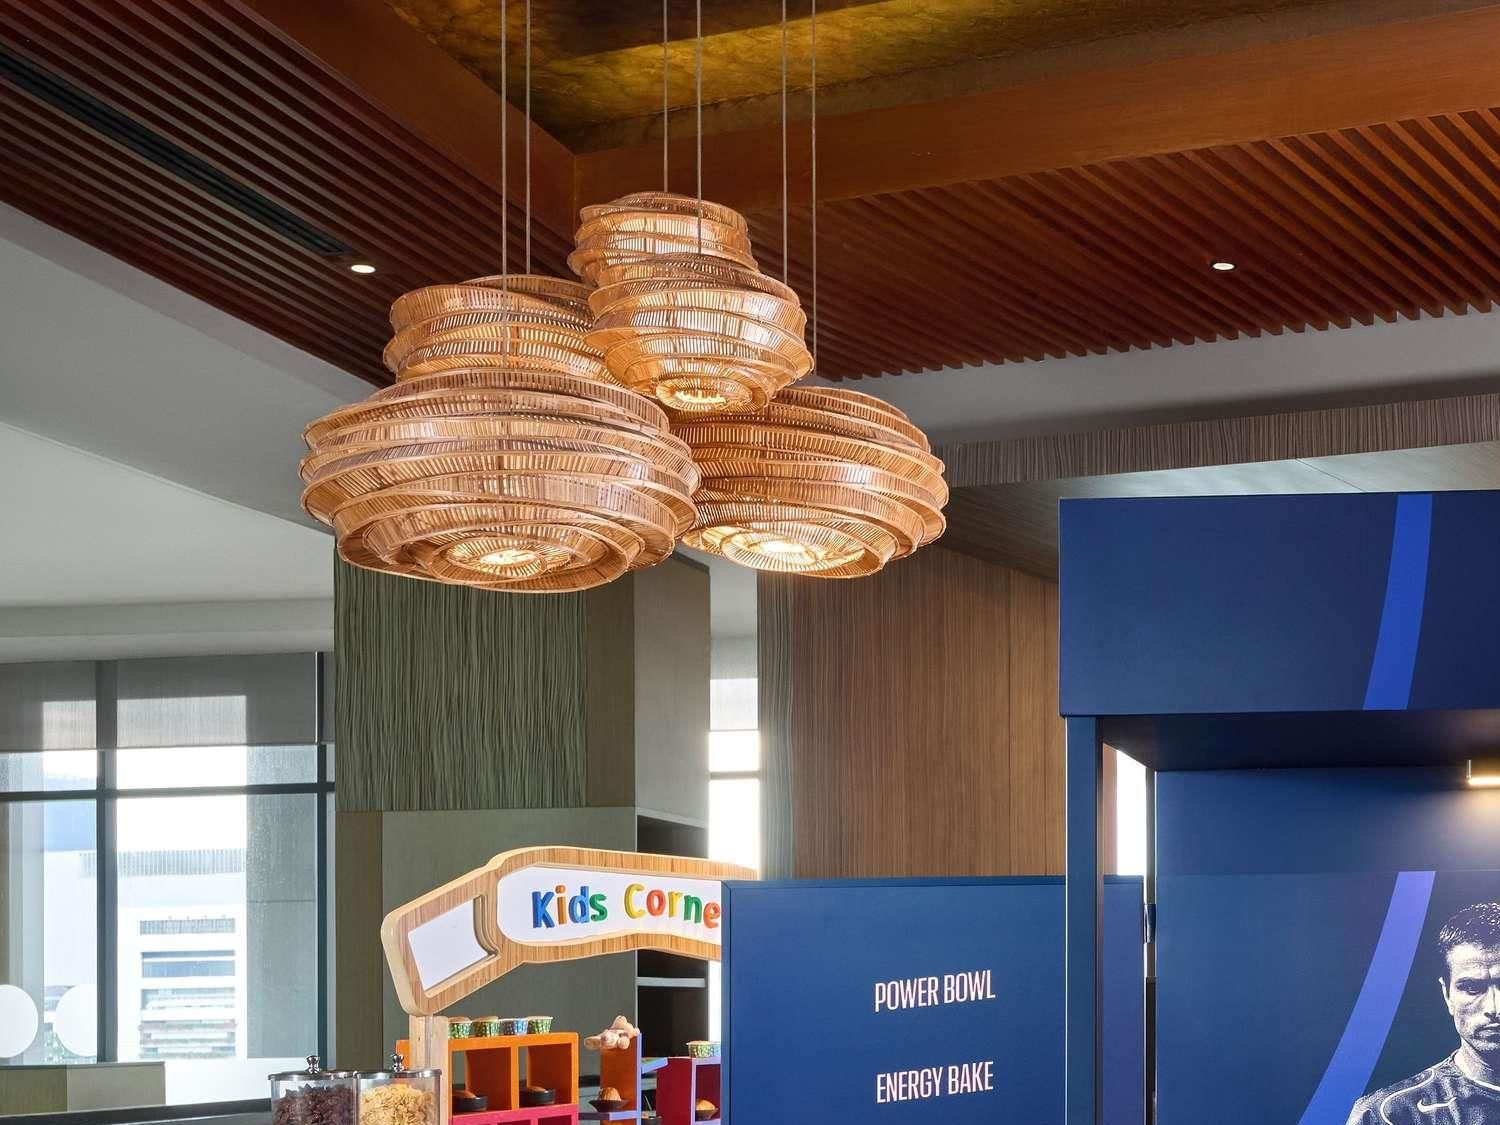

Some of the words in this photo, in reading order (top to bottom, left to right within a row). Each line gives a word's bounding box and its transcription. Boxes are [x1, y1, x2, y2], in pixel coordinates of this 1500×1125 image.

[531, 884, 608, 929] Kids
[623, 882, 721, 929] Corne
[874, 976, 939, 1012] POWER
[943, 969, 996, 1004] BOWL
[876, 1066, 943, 1104] ENERGY
[948, 1061, 994, 1095] BAKE
